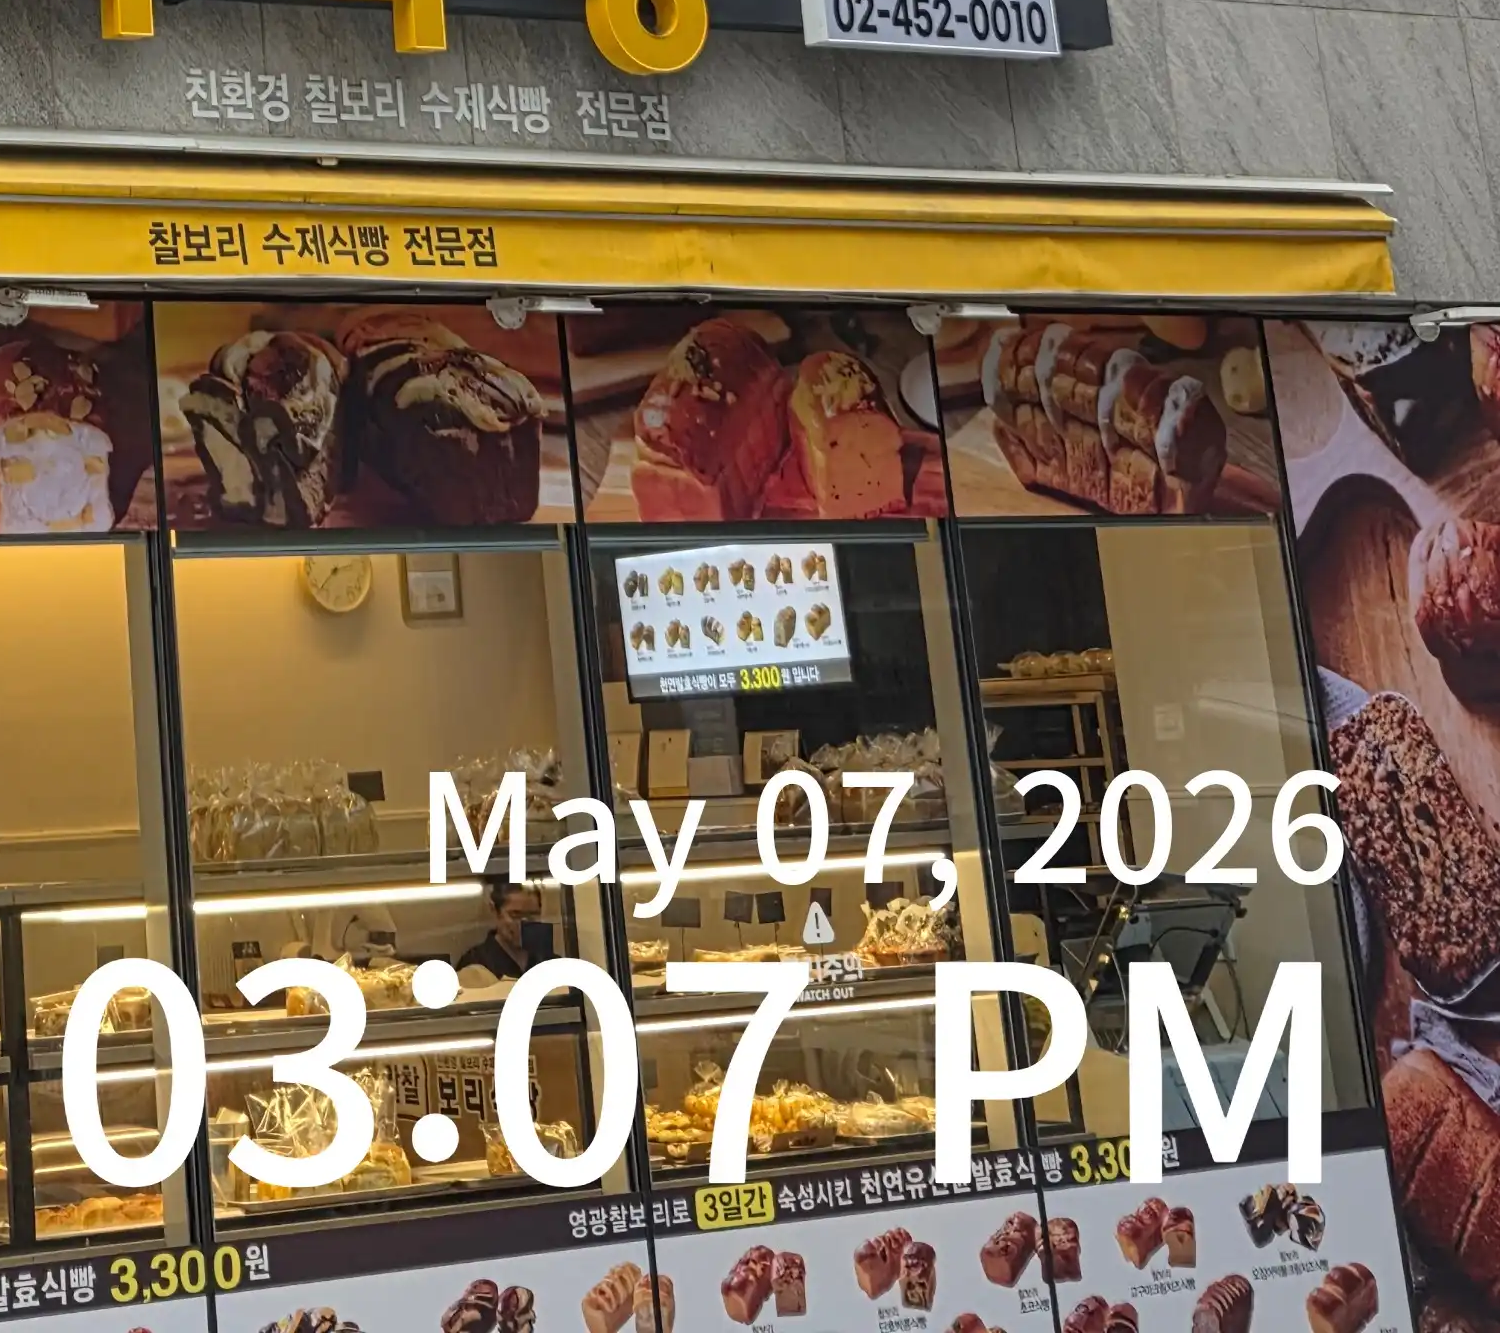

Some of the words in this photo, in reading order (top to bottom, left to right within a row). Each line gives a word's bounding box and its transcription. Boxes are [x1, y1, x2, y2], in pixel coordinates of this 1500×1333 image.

[184, 65, 290, 122] 친환경
[304, 70, 407, 129] 찰보리
[420, 79, 551, 135] 수제식빵
[574, 90, 672, 143] 전문점
[147, 219, 249, 266] 찰보리
[261, 223, 390, 267] 수제식빵
[403, 224, 499, 269] 전문점
[832, 986, 856, 1000] OUT
[568, 1198, 693, 1239] 영광찰보리로
[703, 1187, 767, 1223] 3일간
[777, 1182, 855, 1213] 숙성시킨
[860, 1149, 1064, 1205] 천연유발효식빵
[1070, 1136, 1180, 1186] 3,30원
